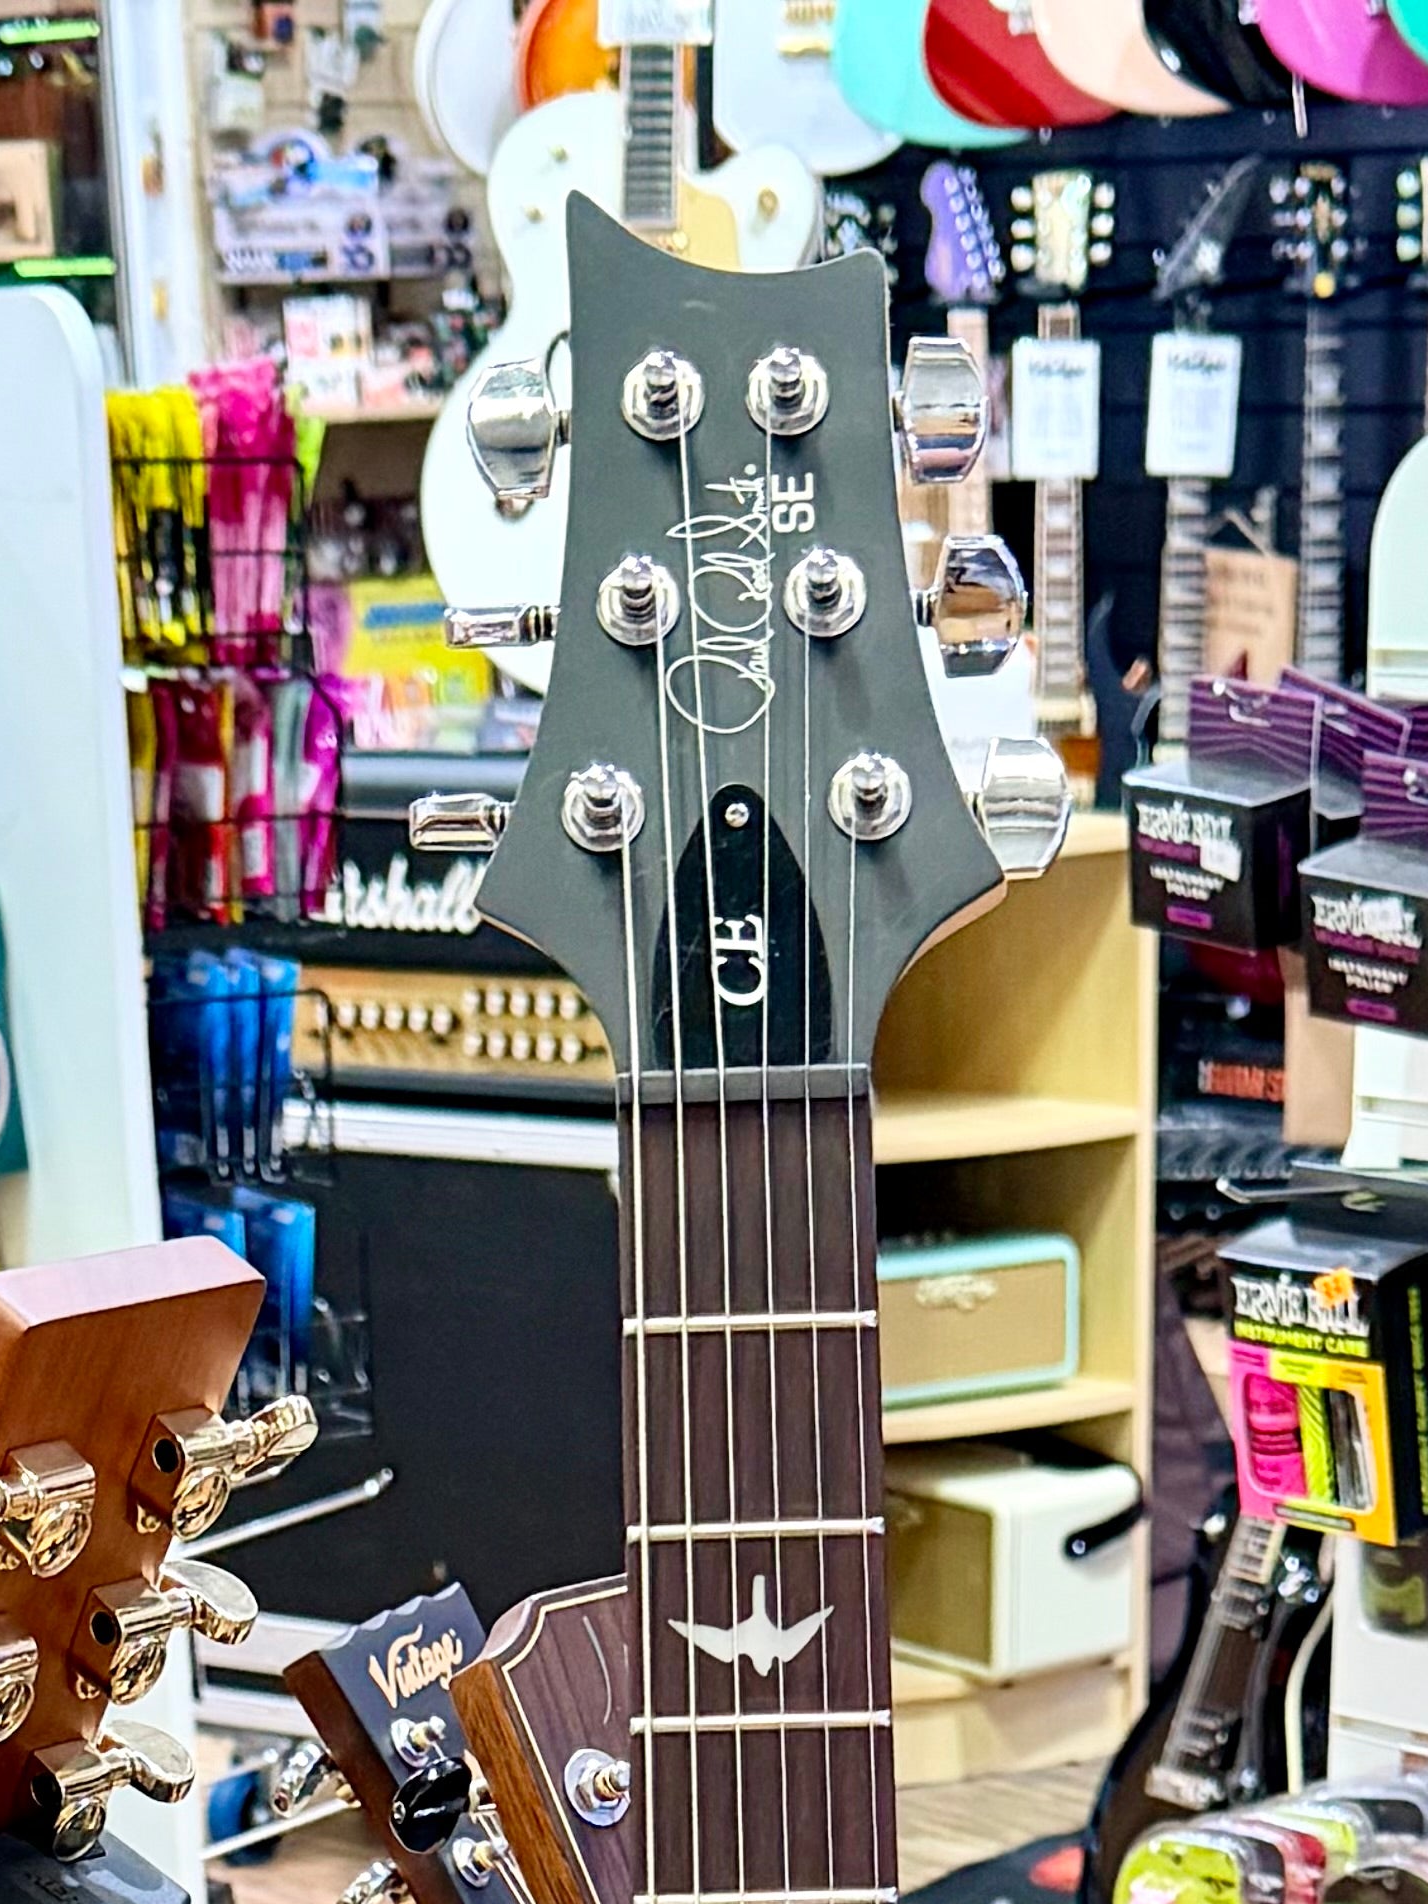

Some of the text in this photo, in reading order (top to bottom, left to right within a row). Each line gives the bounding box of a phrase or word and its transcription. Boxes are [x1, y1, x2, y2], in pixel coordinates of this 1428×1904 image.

[772, 472, 816, 533] SE
[307, 852, 485, 936] rshall
[712, 913, 768, 1006] CE
[368, 1623, 464, 1709] Vintage
